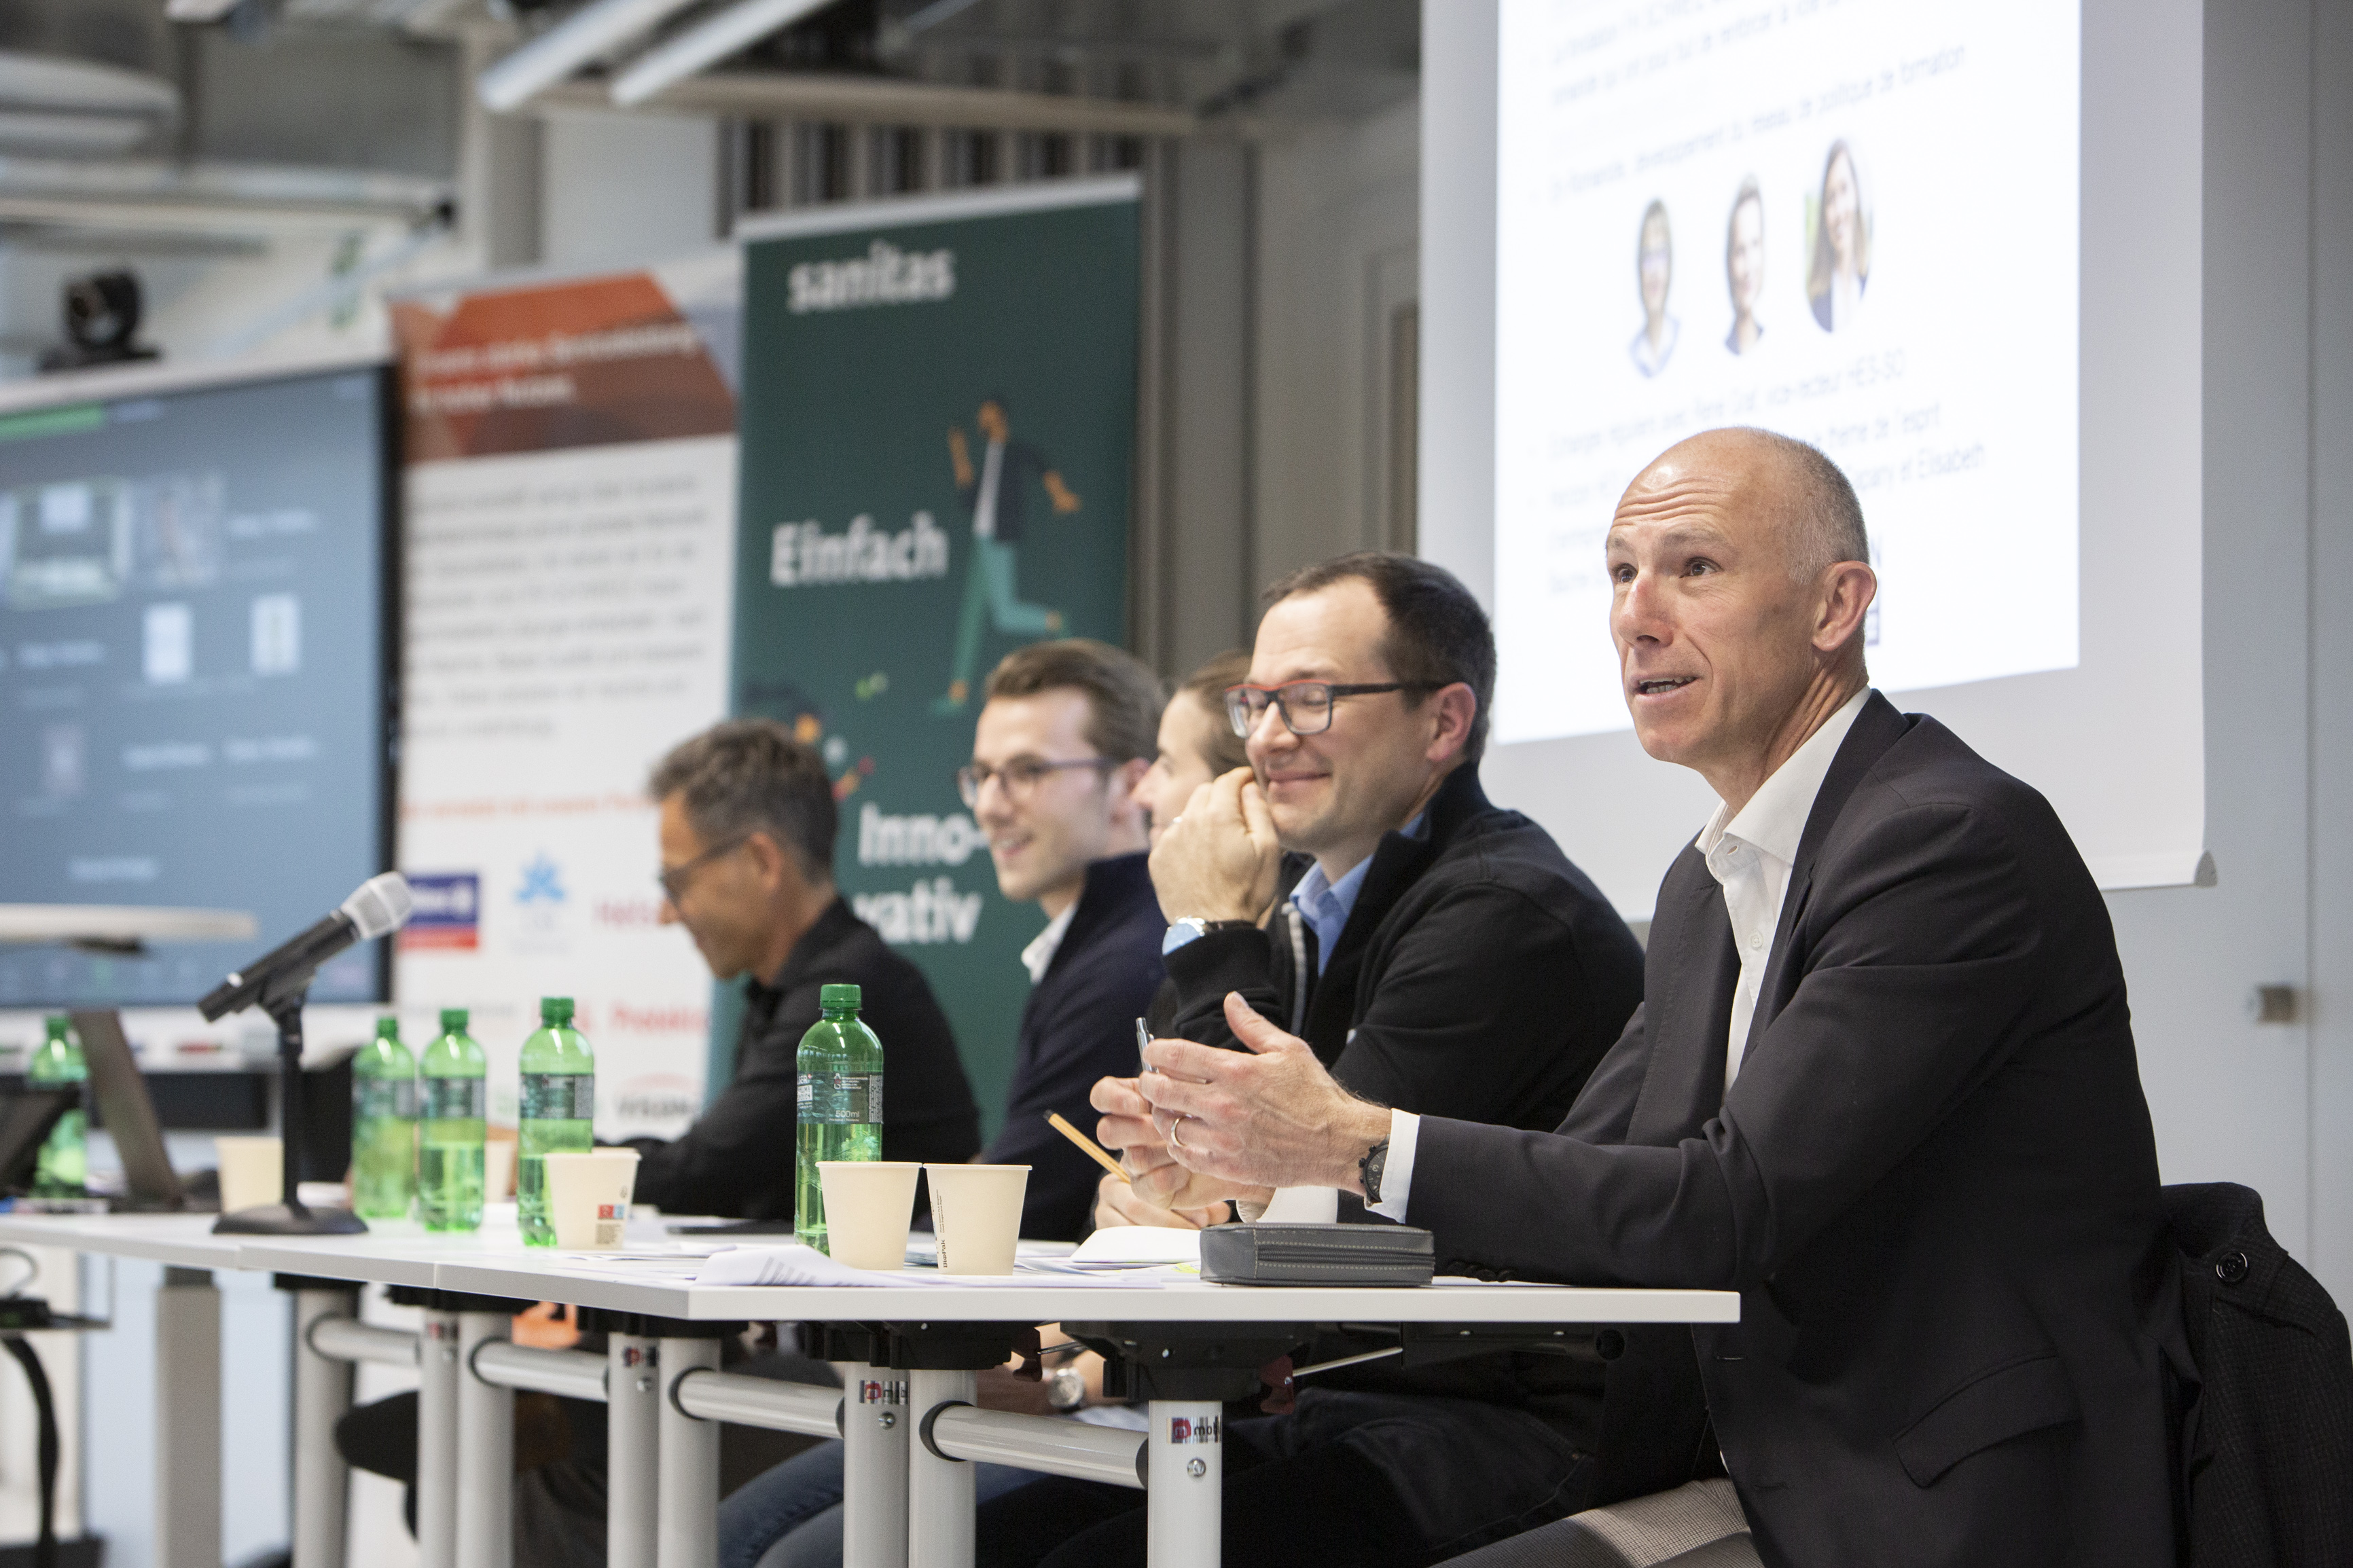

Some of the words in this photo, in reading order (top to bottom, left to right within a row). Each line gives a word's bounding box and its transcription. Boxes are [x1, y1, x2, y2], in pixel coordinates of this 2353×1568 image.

[788, 239, 956, 314] sanitas
[770, 511, 949, 586] Einfach
[859, 800, 990, 867] Inno-
[836, 1110, 859, 1118] 500ml
